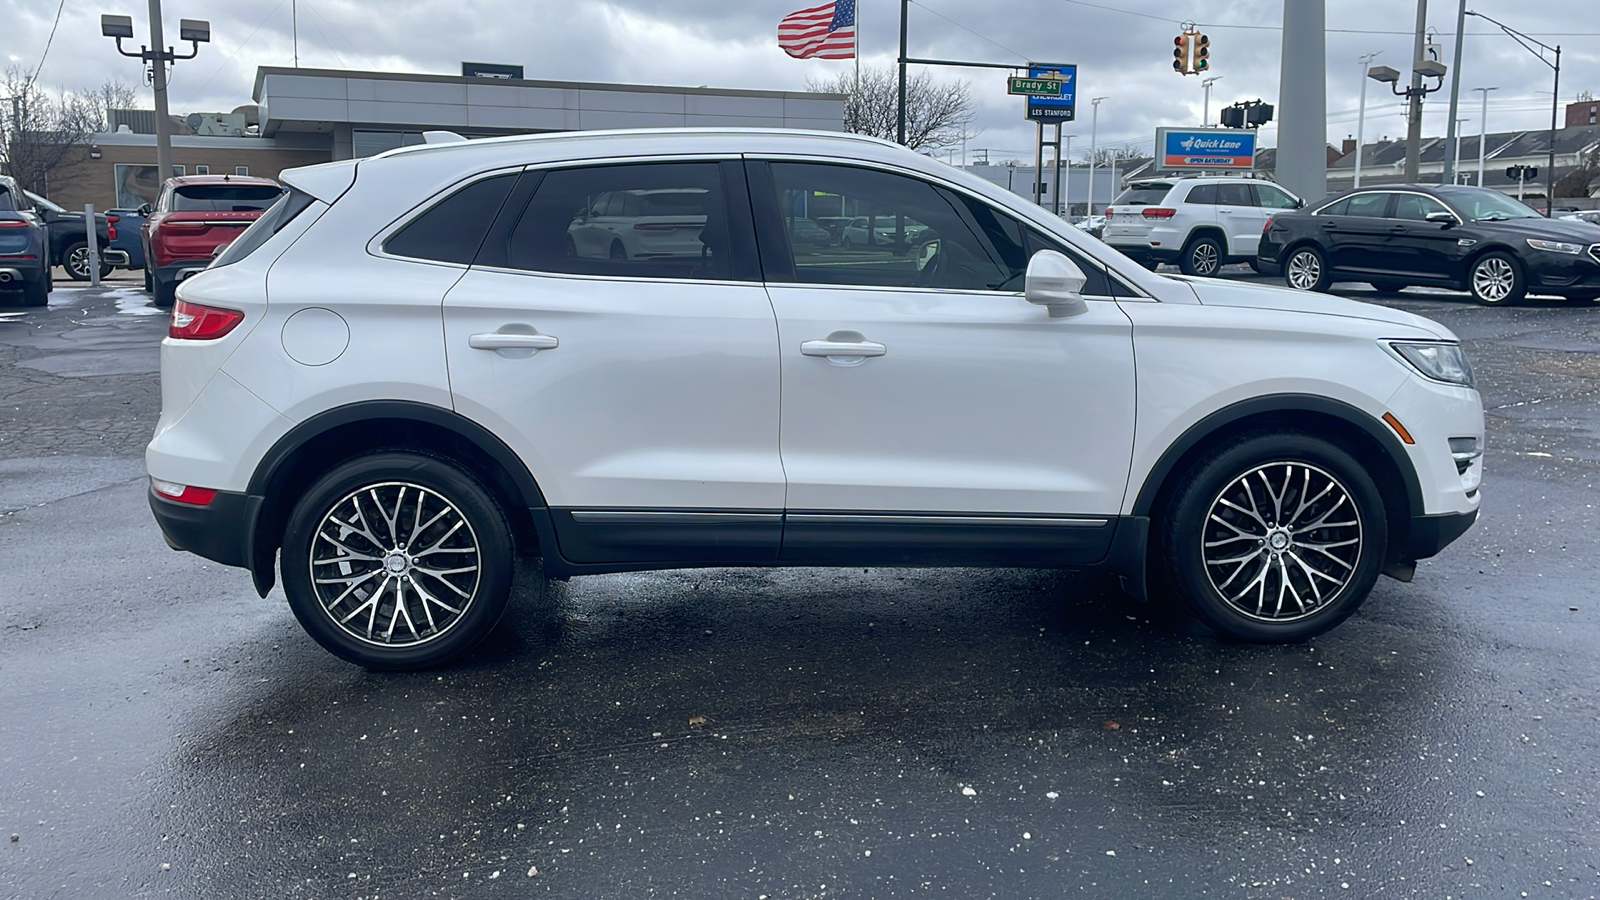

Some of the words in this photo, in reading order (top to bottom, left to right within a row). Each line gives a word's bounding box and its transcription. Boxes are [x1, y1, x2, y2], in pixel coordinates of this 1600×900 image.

[1016, 80, 1042, 90] Brady
[1044, 109, 1071, 117] STANFORD
[1194, 139, 1219, 149] Quick
[1219, 140, 1241, 149] Lane
